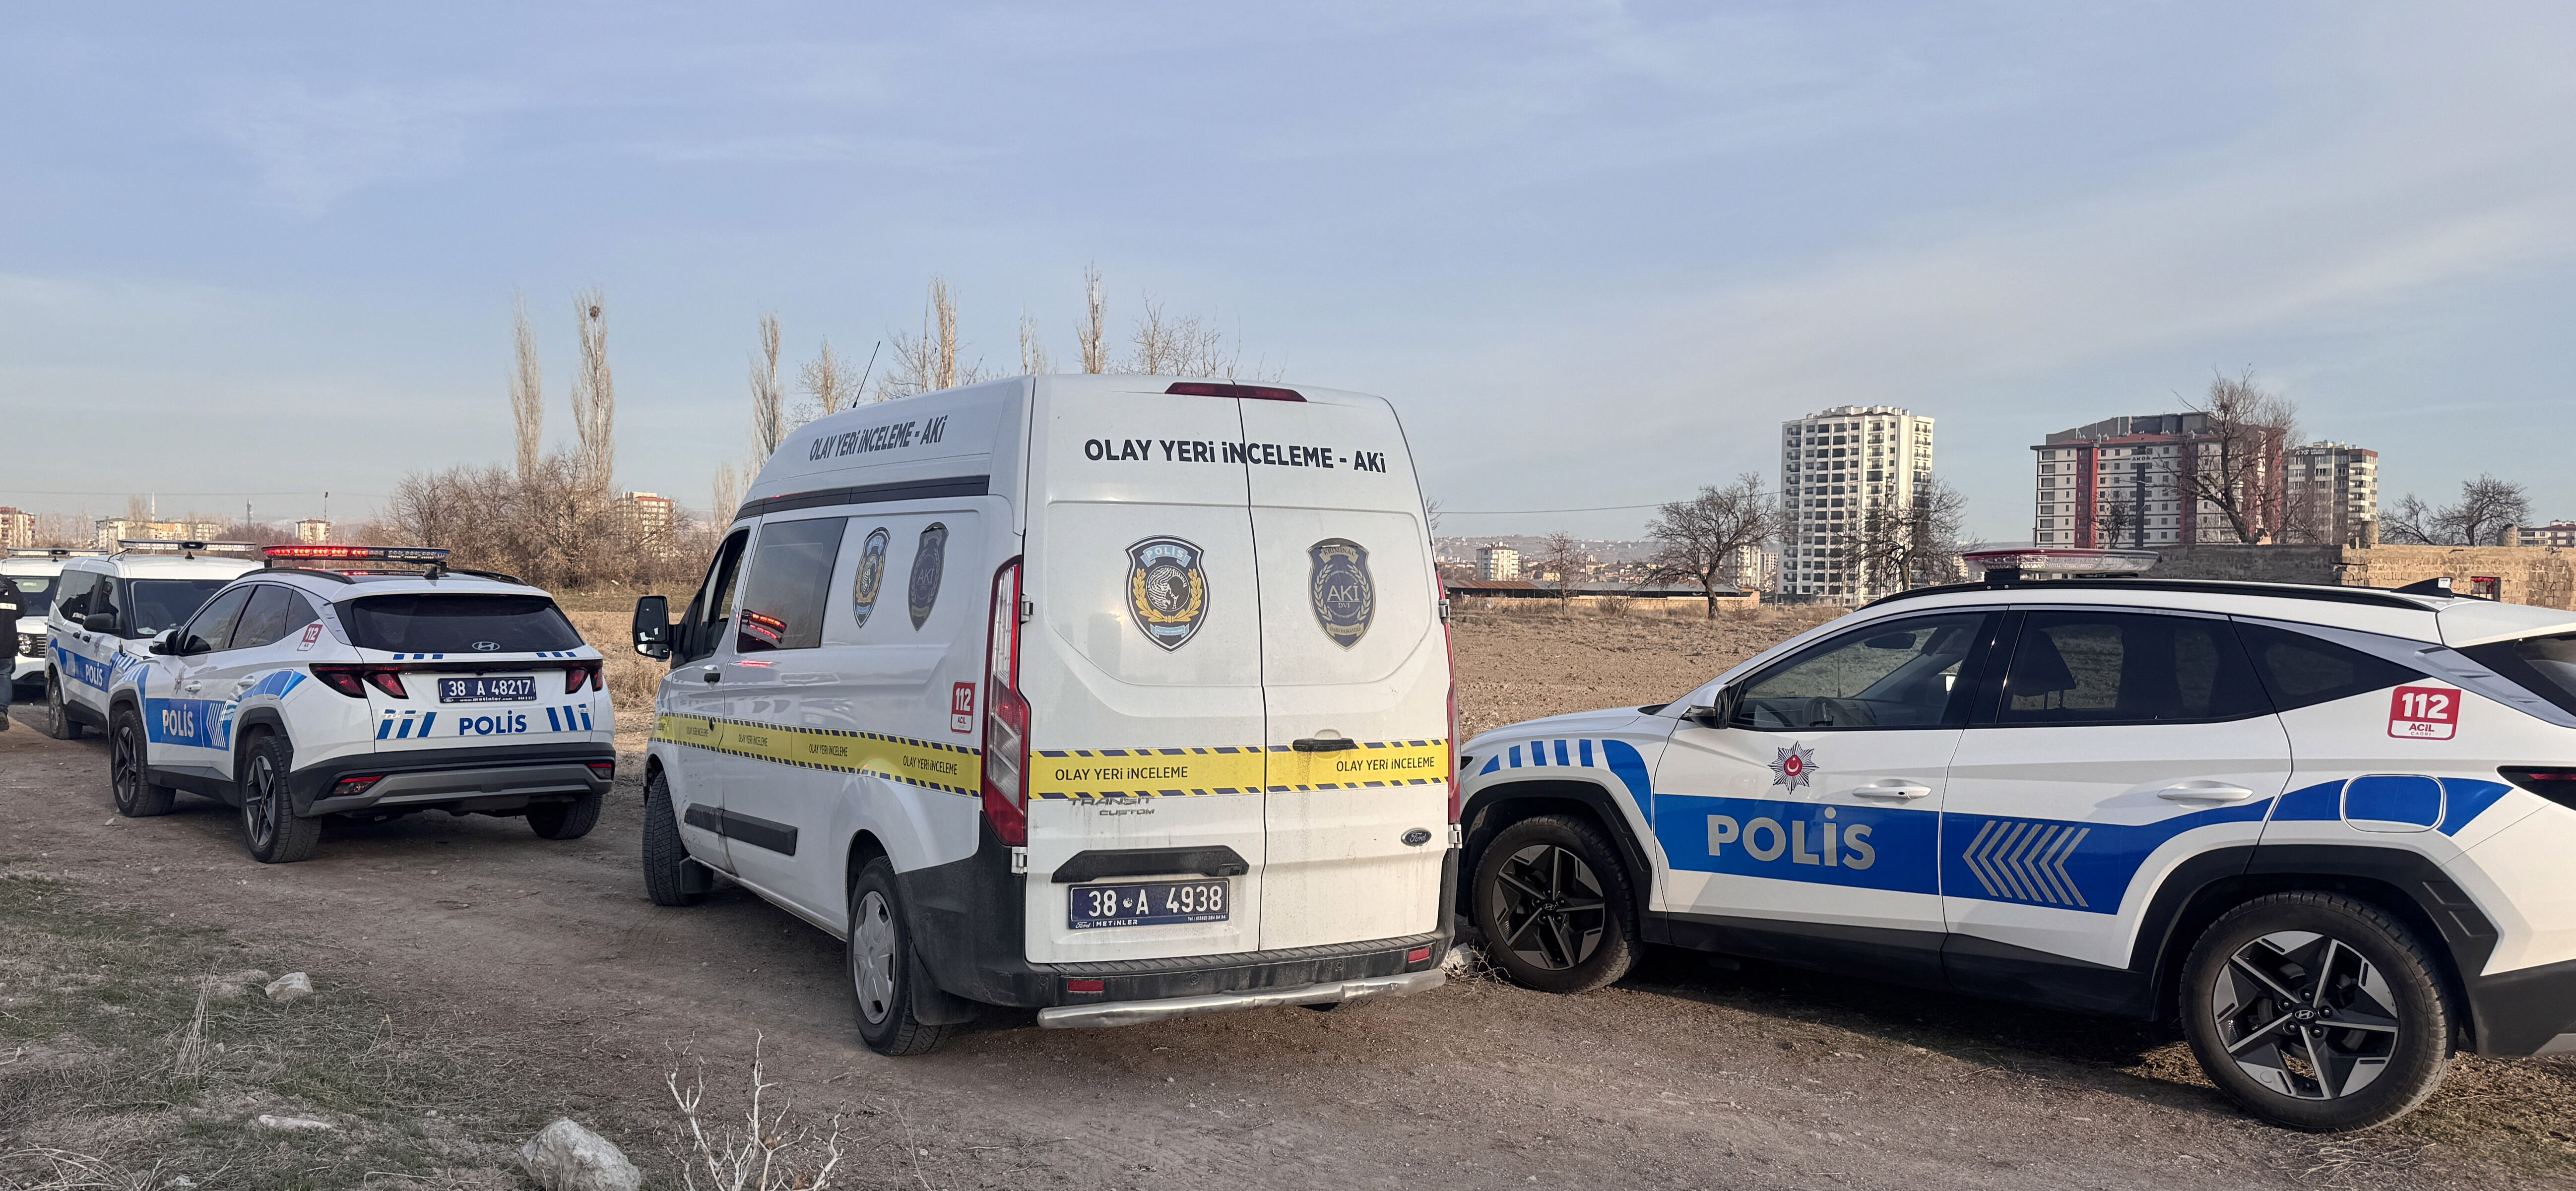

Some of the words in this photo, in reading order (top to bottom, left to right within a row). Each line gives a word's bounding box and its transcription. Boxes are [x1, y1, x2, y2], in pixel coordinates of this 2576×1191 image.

[809, 435, 837, 461] OLAY
[835, 430, 861, 457] YERİ
[920, 415, 948, 445] AKİ
[1084, 439, 1152, 461] OLAY
[1159, 440, 1216, 463] YERİ
[1221, 441, 1334, 469] İNCELEME
[1353, 450, 1386, 473] AKİ
[1145, 547, 1185, 559] POLİS
[1327, 582, 1359, 602] AKİ
[305, 627, 319, 640] 112
[85, 662, 103, 687] POLİS
[448, 681, 466, 696] 38
[477, 680, 486, 695] A
[491, 680, 531, 695] 48217
[956, 688, 971, 711] 112
[2402, 692, 2449, 719] 112
[162, 703, 194, 738] POLİS
[459, 710, 527, 736] POLİS
[2409, 723, 2435, 732] ACİL
[903, 755, 916, 768] OLAY
[917, 757, 929, 770] YERİ
[1336, 760, 1363, 772] OLAY
[1366, 758, 1388, 771] YERİ
[1391, 756, 1435, 770] İNCELEME
[1055, 769, 1091, 781] OLAY
[1094, 767, 1123, 780] YERİ
[1127, 766, 1188, 780] İNCELEME
[1067, 795, 1155, 806] TRANSIT
[1410, 832, 1427, 843] Ford
[1707, 807, 1876, 870] POLİS
[1088, 890, 1117, 917] 38
[1136, 889, 1149, 915] A
[1166, 885, 1223, 914] 4938
